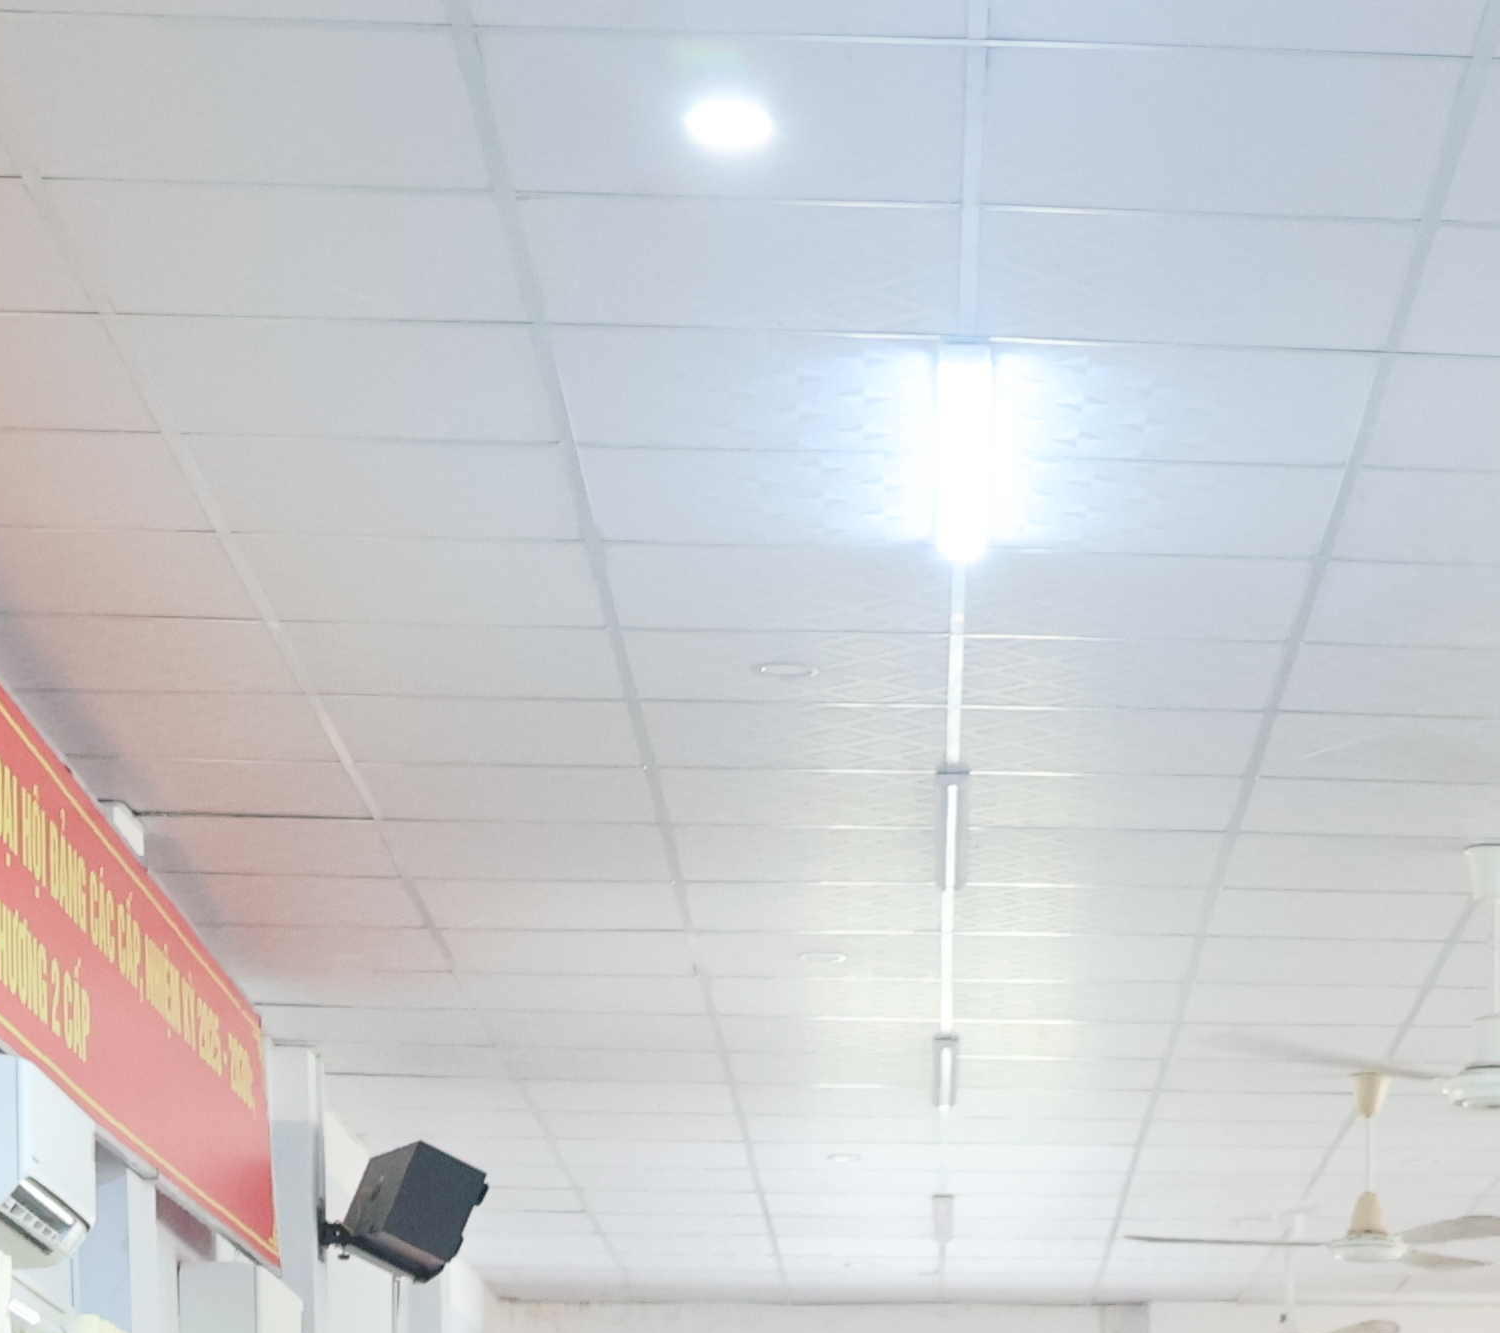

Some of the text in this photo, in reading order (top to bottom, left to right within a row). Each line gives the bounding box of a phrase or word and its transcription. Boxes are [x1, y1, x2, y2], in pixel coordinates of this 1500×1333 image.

[21, 784, 46, 898] HỘI
[50, 808, 87, 933] ĐẢNG
[89, 867, 115, 964] CÁC
[51, 957, 61, 1036] 2
[63, 958, 90, 1062] CẤP
